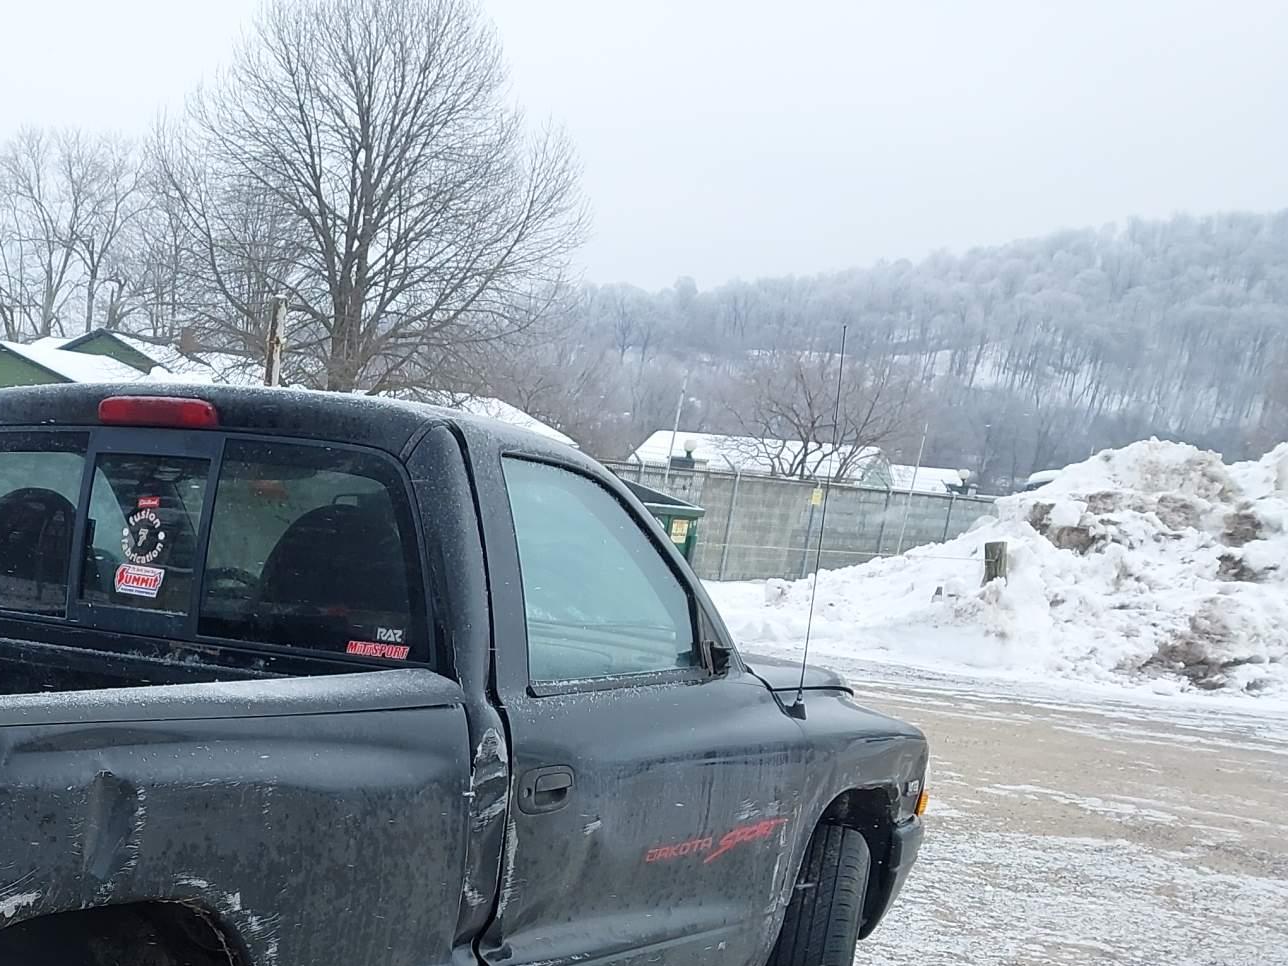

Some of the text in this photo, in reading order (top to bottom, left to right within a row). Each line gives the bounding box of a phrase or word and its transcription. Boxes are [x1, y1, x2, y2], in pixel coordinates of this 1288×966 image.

[128, 508, 161, 529] fusion
[121, 539, 164, 564] fabrication
[117, 567, 159, 588] SUMMIT
[376, 627, 403, 642] RAZ
[645, 818, 789, 863] DAKOTA SPORT
